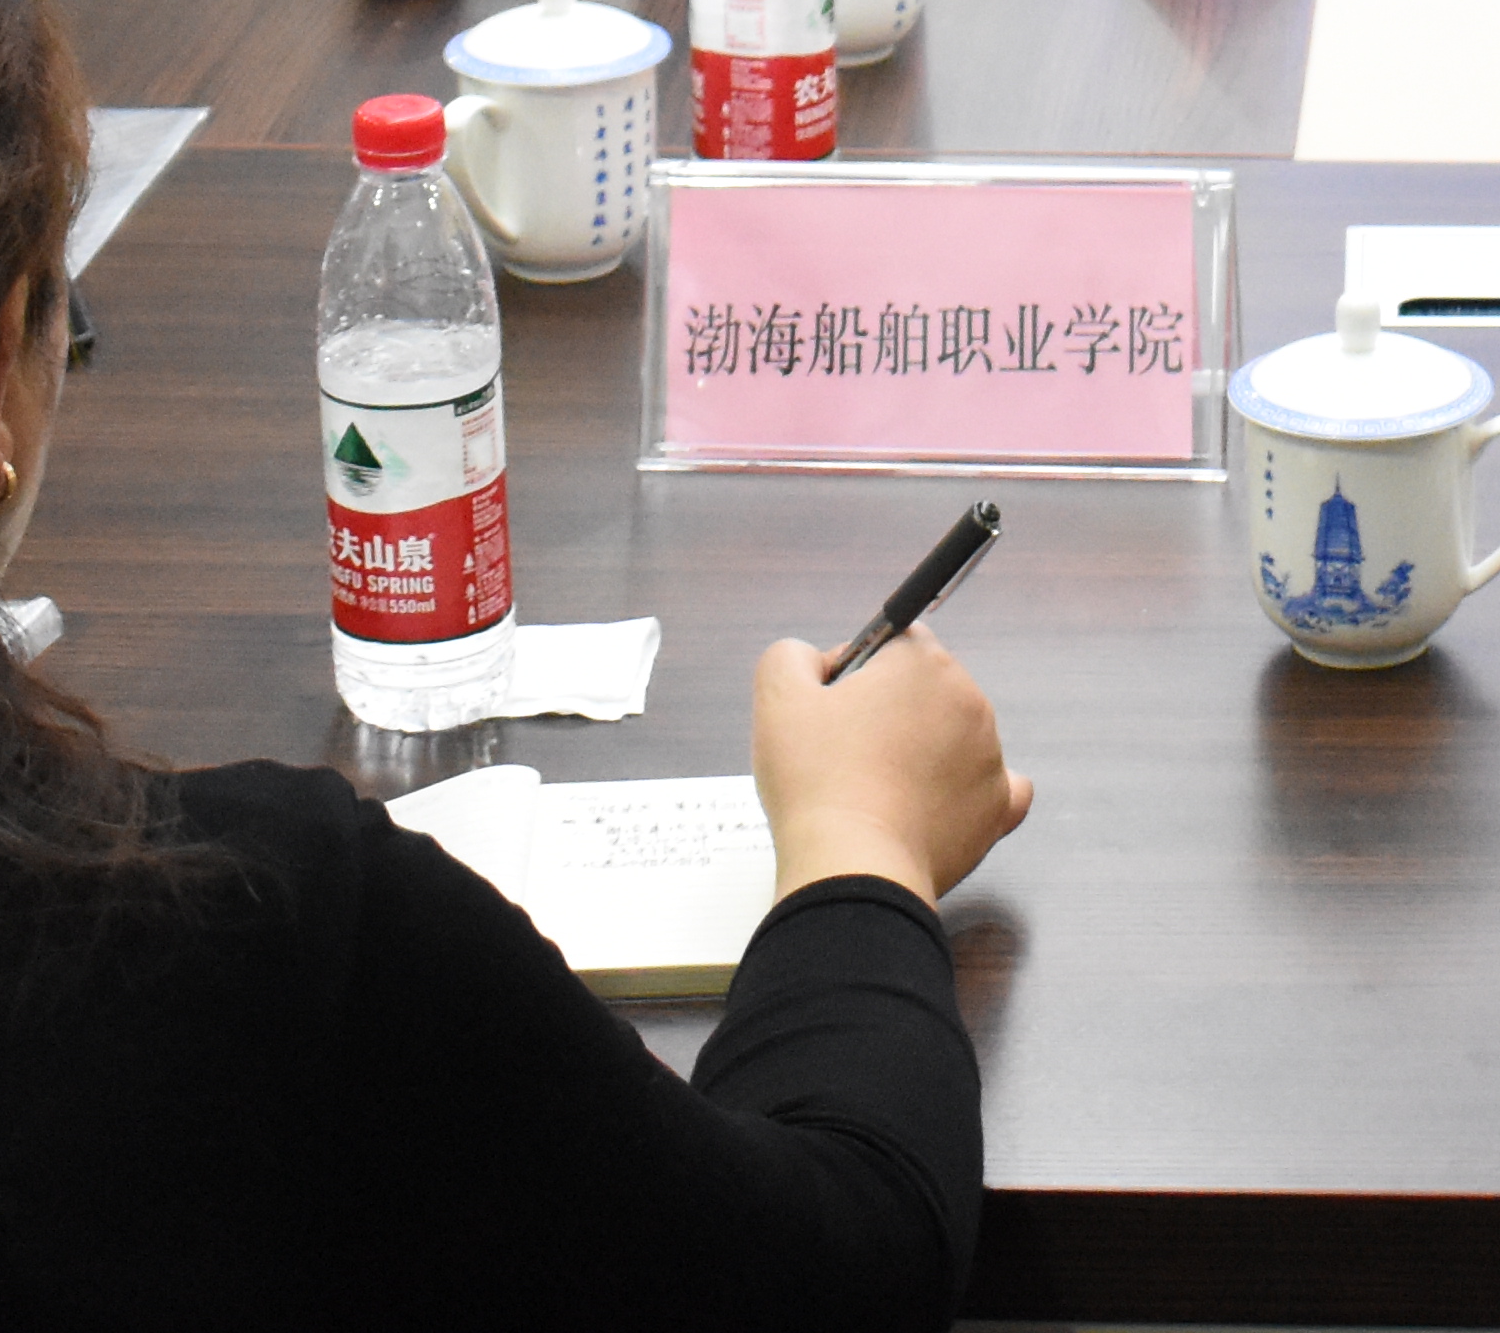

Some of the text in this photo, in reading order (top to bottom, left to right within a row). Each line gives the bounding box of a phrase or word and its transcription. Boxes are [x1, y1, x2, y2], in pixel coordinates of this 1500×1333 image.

[683, 302, 1186, 377] 渤海船舶职业学院
[367, 575, 435, 594] SPRING
